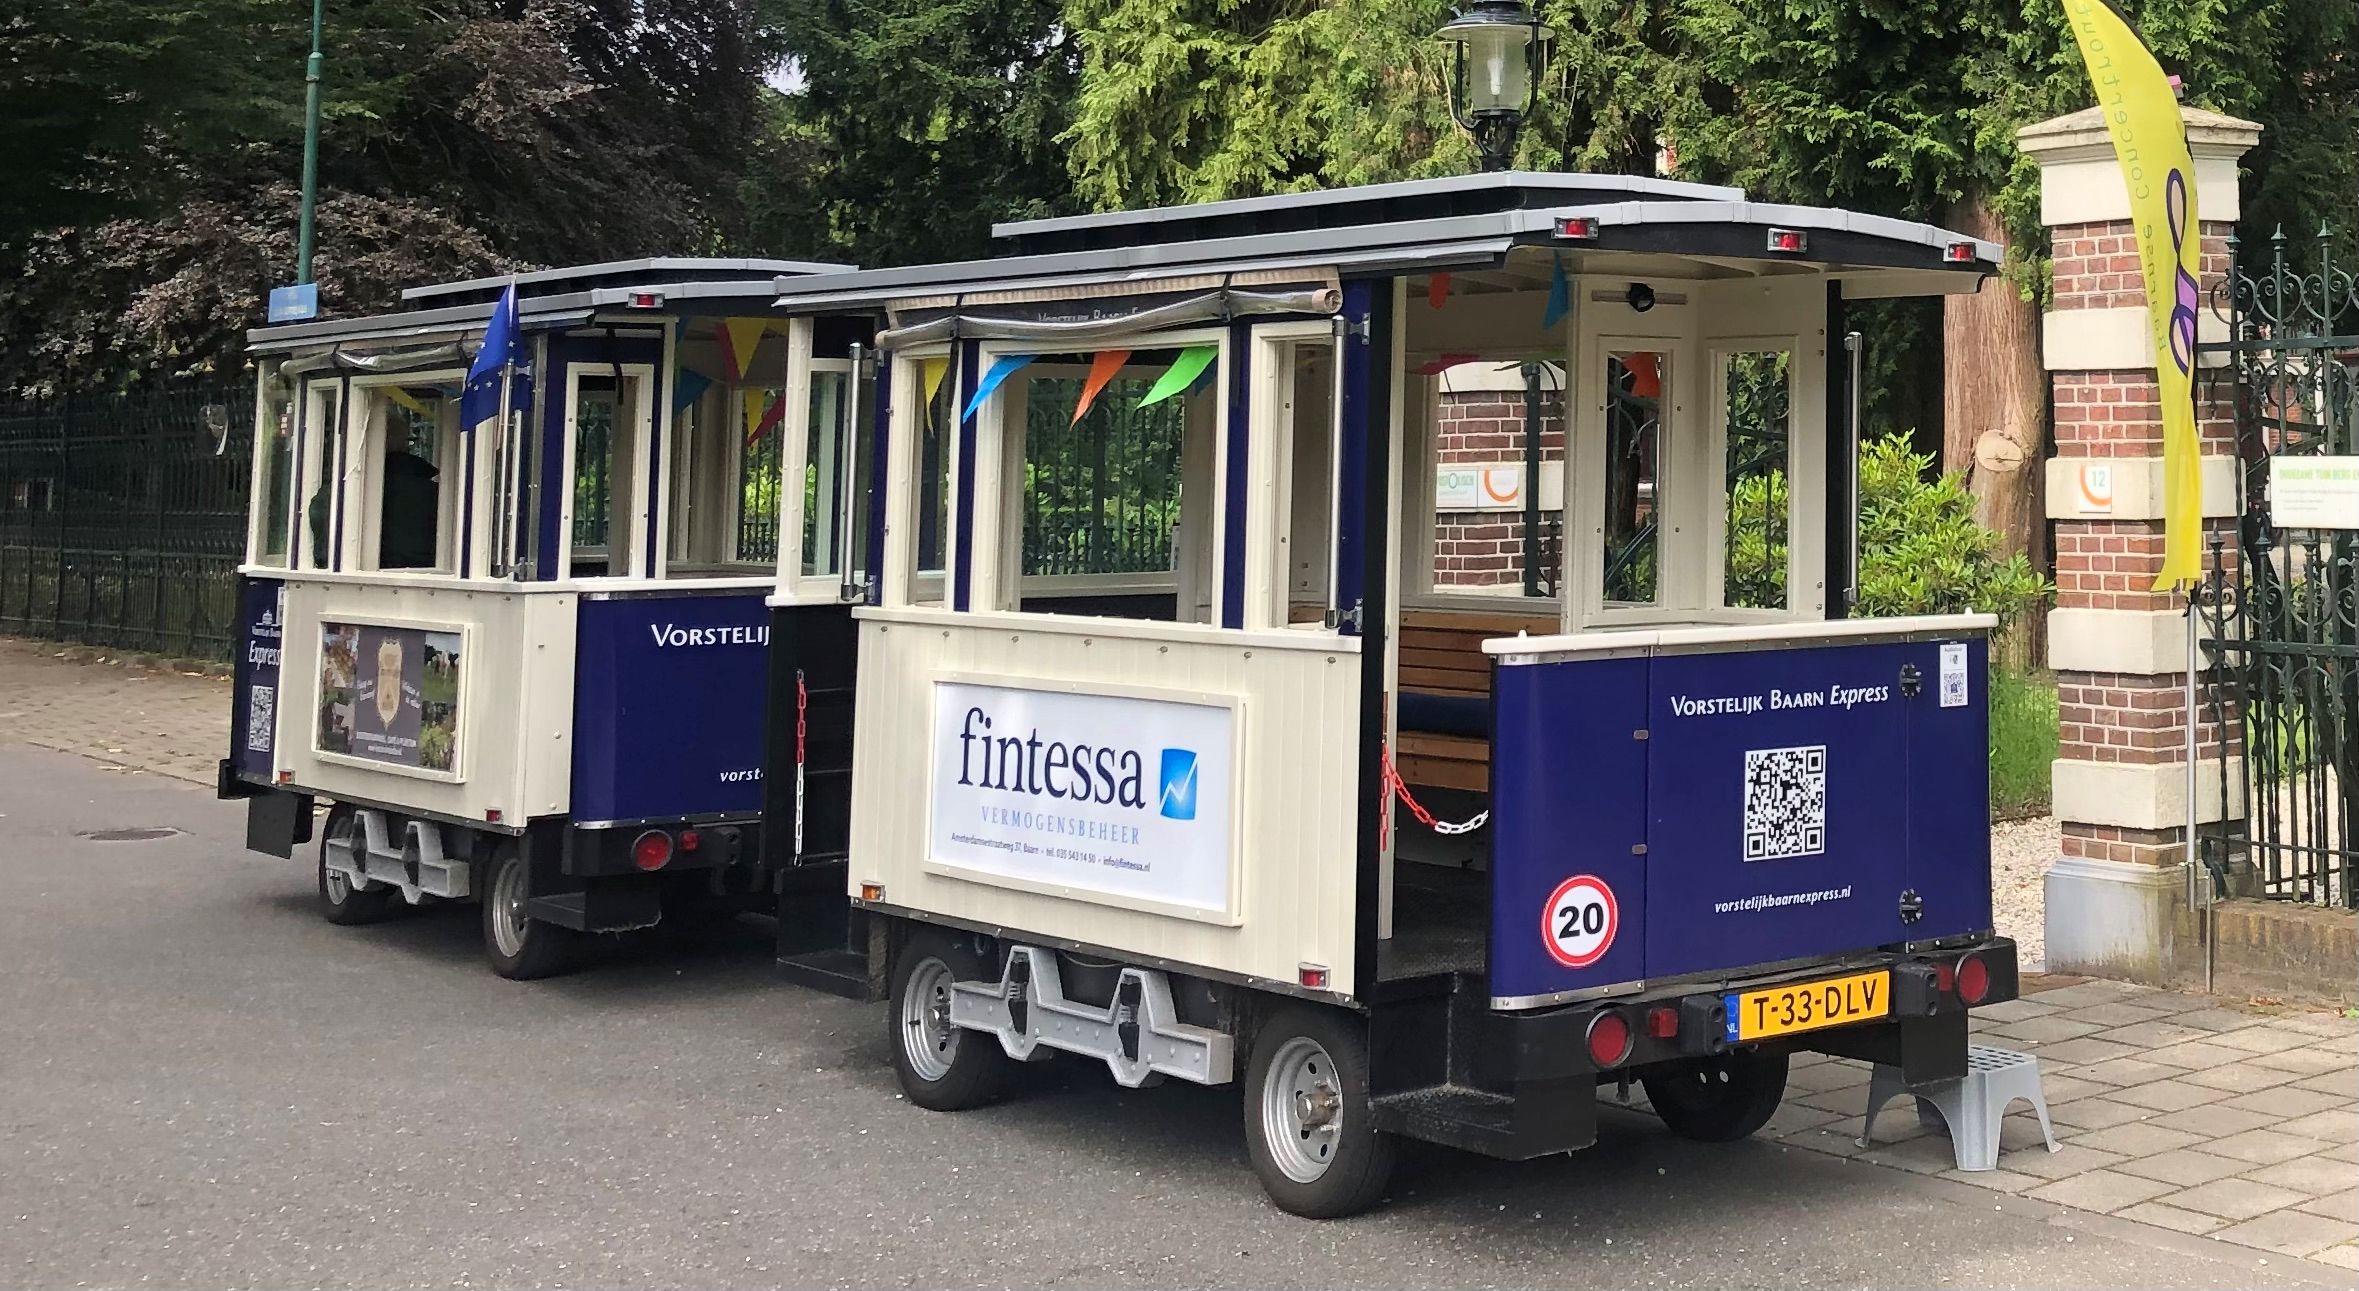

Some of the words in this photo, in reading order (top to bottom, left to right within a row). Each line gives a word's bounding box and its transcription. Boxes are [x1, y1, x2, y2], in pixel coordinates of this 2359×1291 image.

[2092, 470, 2106, 487] 12
[1670, 694, 1763, 717] VORSTELIJK
[1770, 688, 1824, 710] BAARN
[1830, 684, 1889, 710] Express
[720, 767, 764, 782] vorst
[958, 706, 1146, 809] fintessa
[981, 805, 1139, 845] VERMOGENSBEHEER
[1714, 884, 1852, 913] vorstelijkbaarnexpress.nl
[1558, 902, 1604, 940] 20
[1726, 1022, 1739, 1034] NL
[1753, 978, 1878, 1031] T-33-DLV
